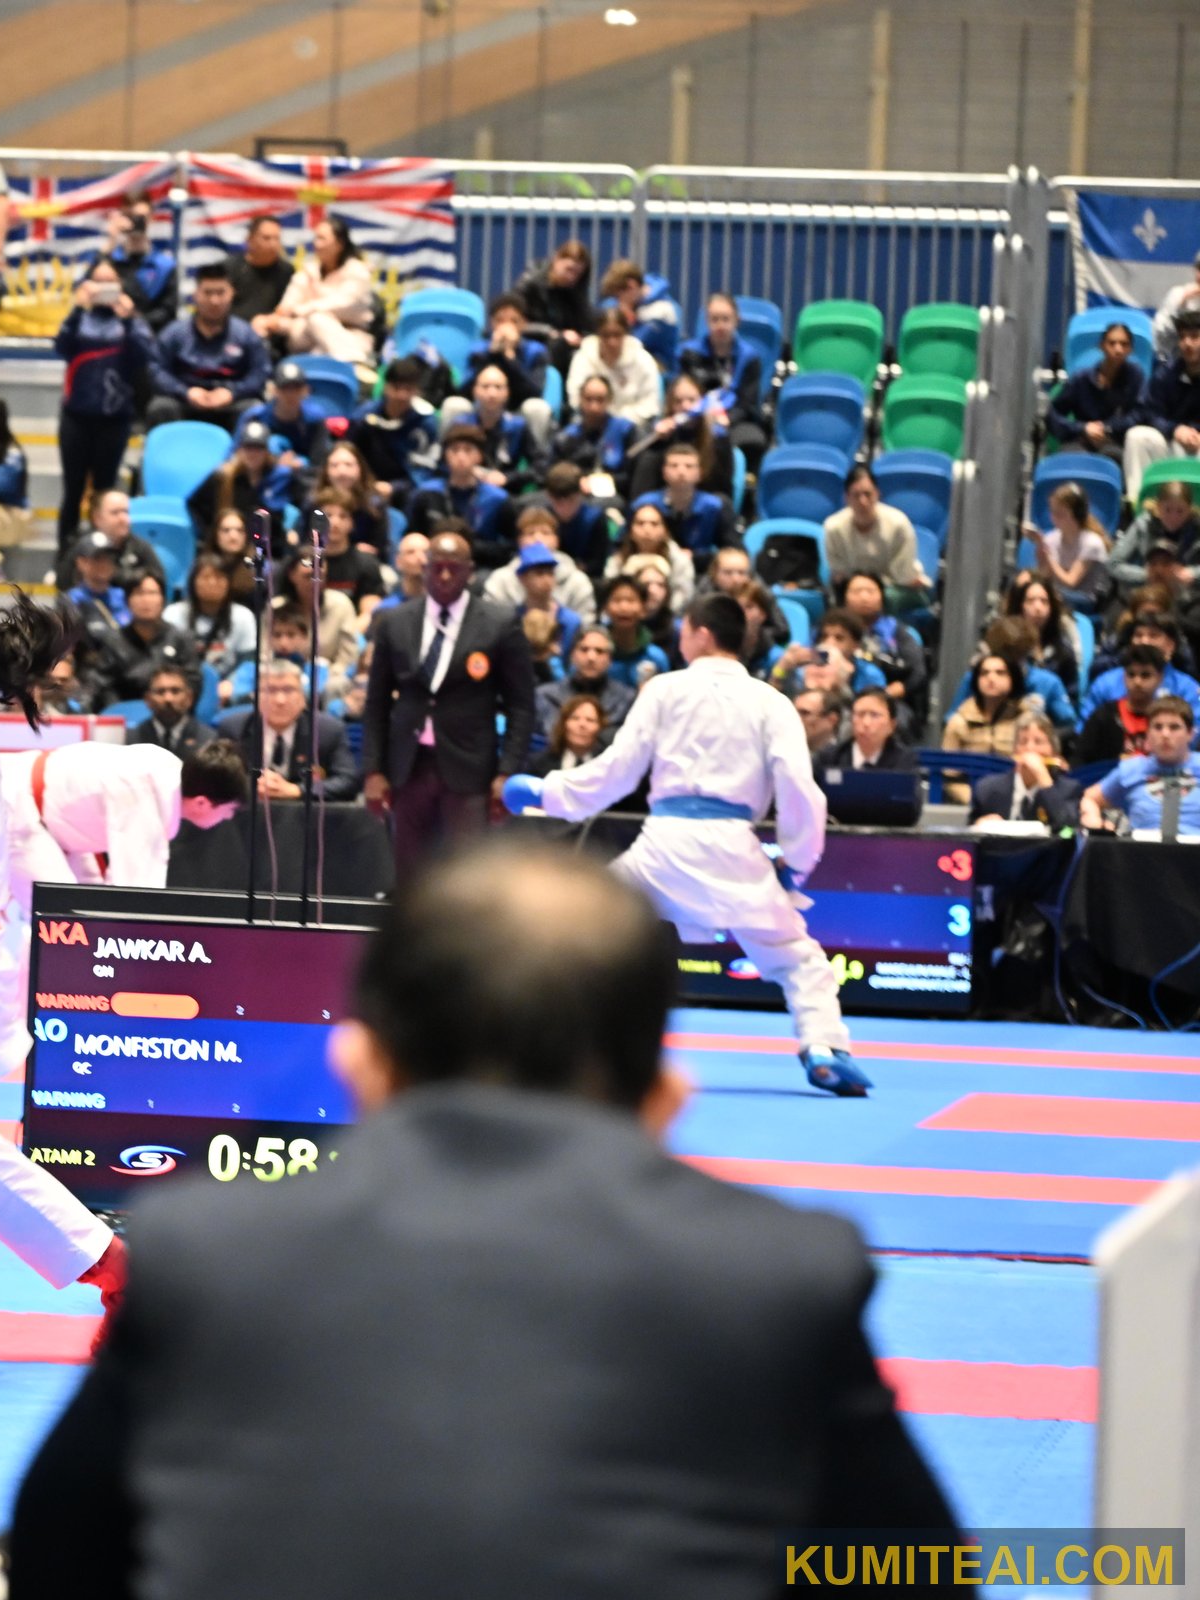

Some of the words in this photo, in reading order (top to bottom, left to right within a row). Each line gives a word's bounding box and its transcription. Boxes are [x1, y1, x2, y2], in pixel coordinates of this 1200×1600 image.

[947, 904, 971, 937] 3
[93, 937, 186, 963] JAWKAR
[188, 941, 212, 964] A.
[92, 964, 114, 978] ON
[74, 1033, 210, 1062] MONFISTON
[214, 1040, 242, 1063] M.
[29, 1147, 82, 1165] ATAMI
[83, 1149, 96, 1166] 2
[207, 1133, 319, 1182] 0:58
